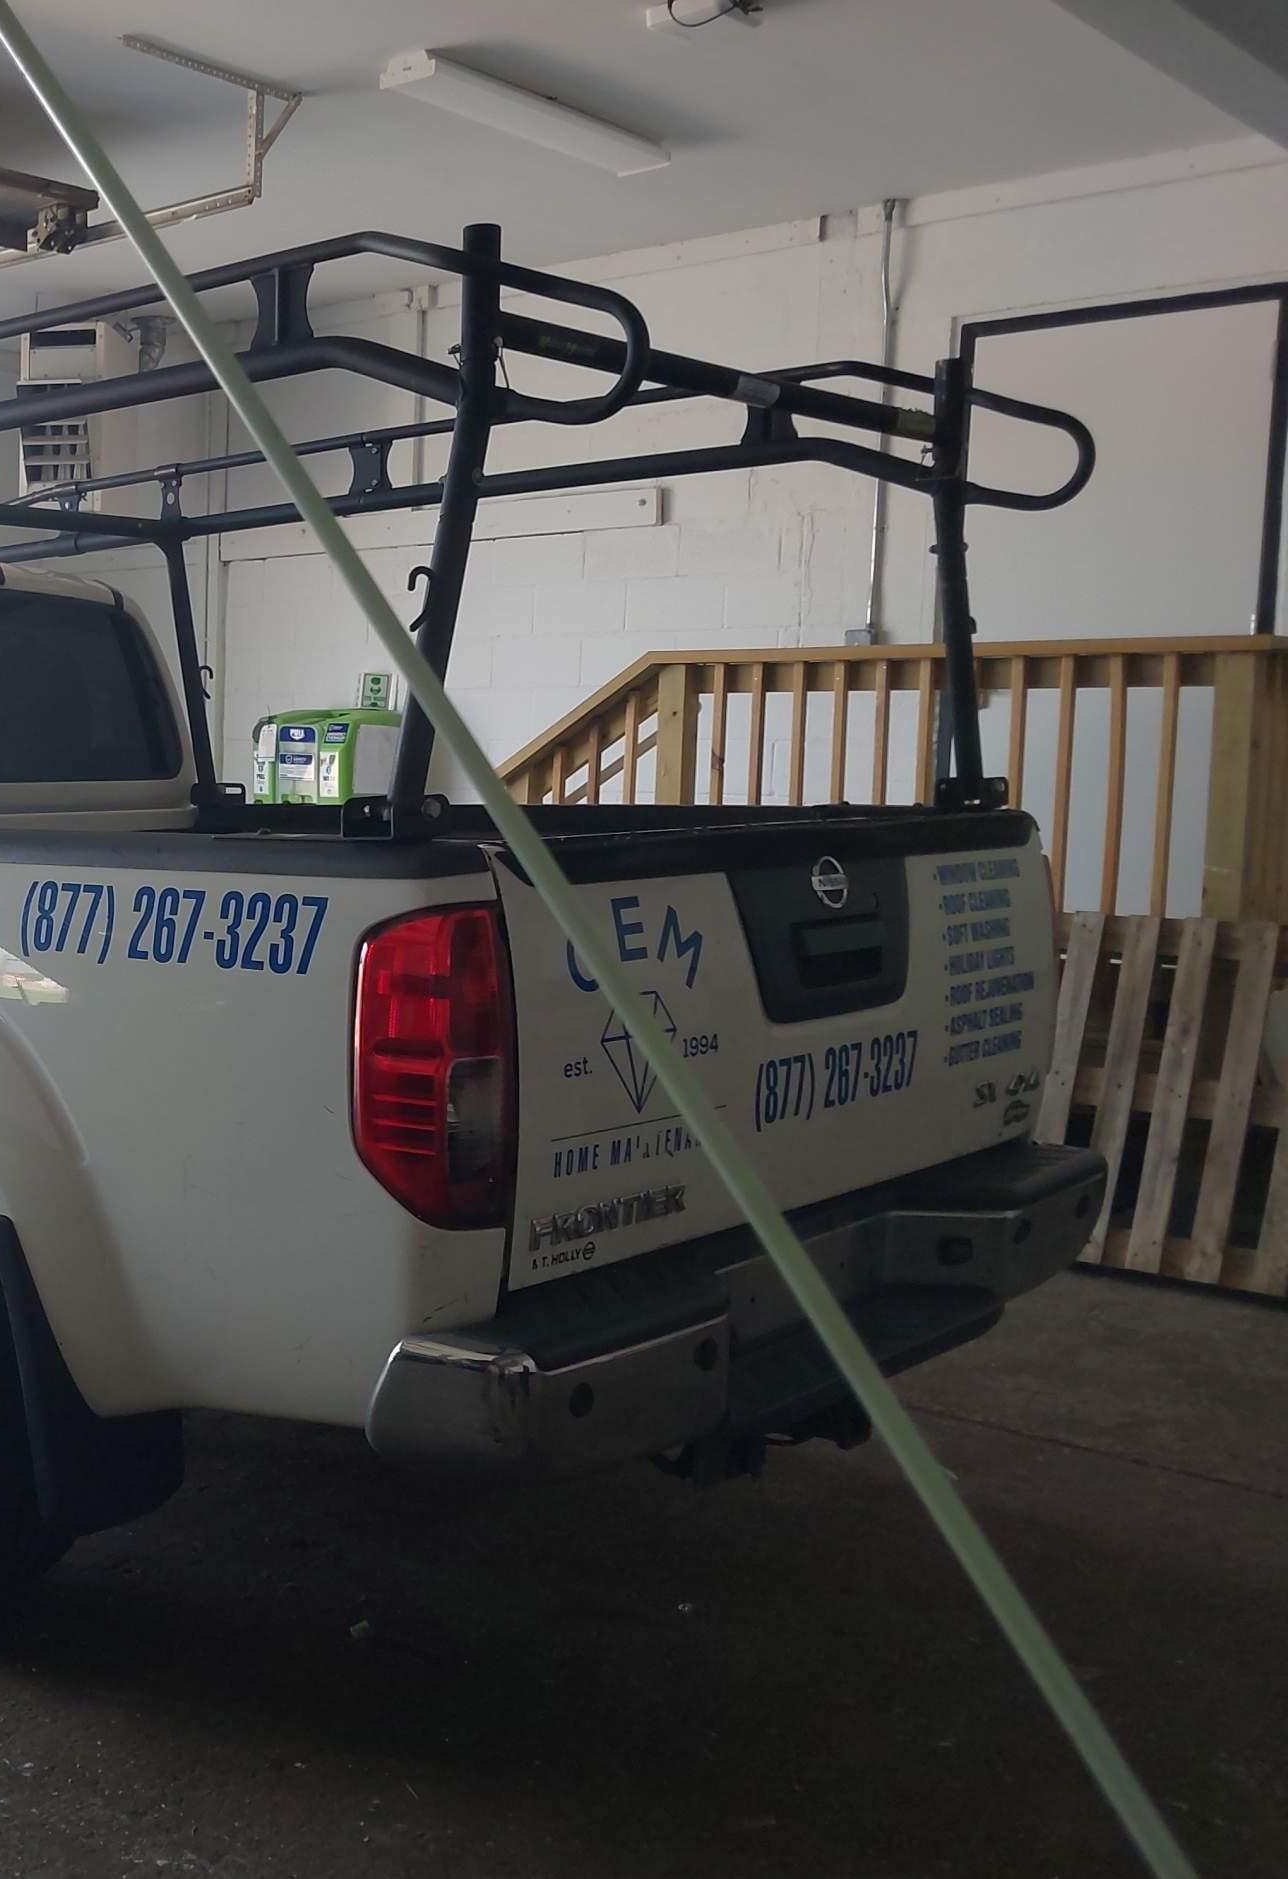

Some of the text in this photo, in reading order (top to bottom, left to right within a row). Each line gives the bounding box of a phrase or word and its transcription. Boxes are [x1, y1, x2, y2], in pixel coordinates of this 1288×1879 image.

[21, 881, 329, 975] (877) 267-3237
[682, 1033, 720, 1058] 1994
[562, 1056, 593, 1079] est.
[755, 1029, 918, 1133] (877) 267-3237
[553, 1143, 601, 1179] HOME
[528, 1185, 687, 1252] FRONTIER
[551, 1247, 582, 1265] HOLLY
